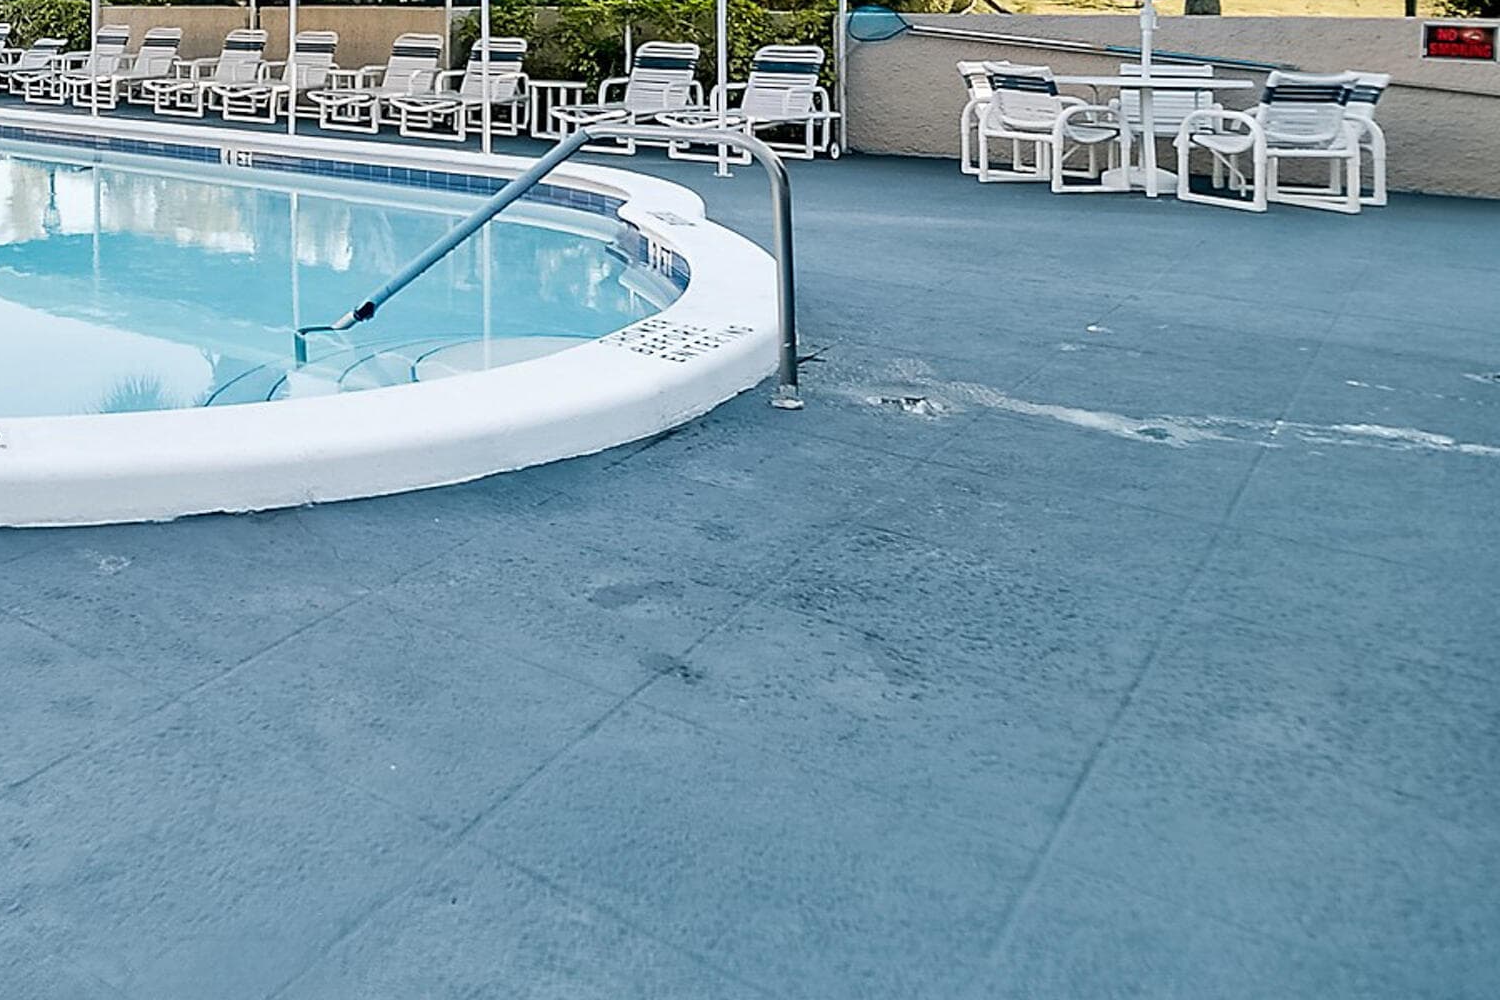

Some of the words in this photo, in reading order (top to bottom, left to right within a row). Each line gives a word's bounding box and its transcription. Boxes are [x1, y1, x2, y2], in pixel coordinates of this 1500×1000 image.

[1436, 28, 1457, 41] NO
[1429, 42, 1492, 58] SMOKING
[630, 324, 708, 356] BEFORE
[660, 324, 755, 363] ENTERING
